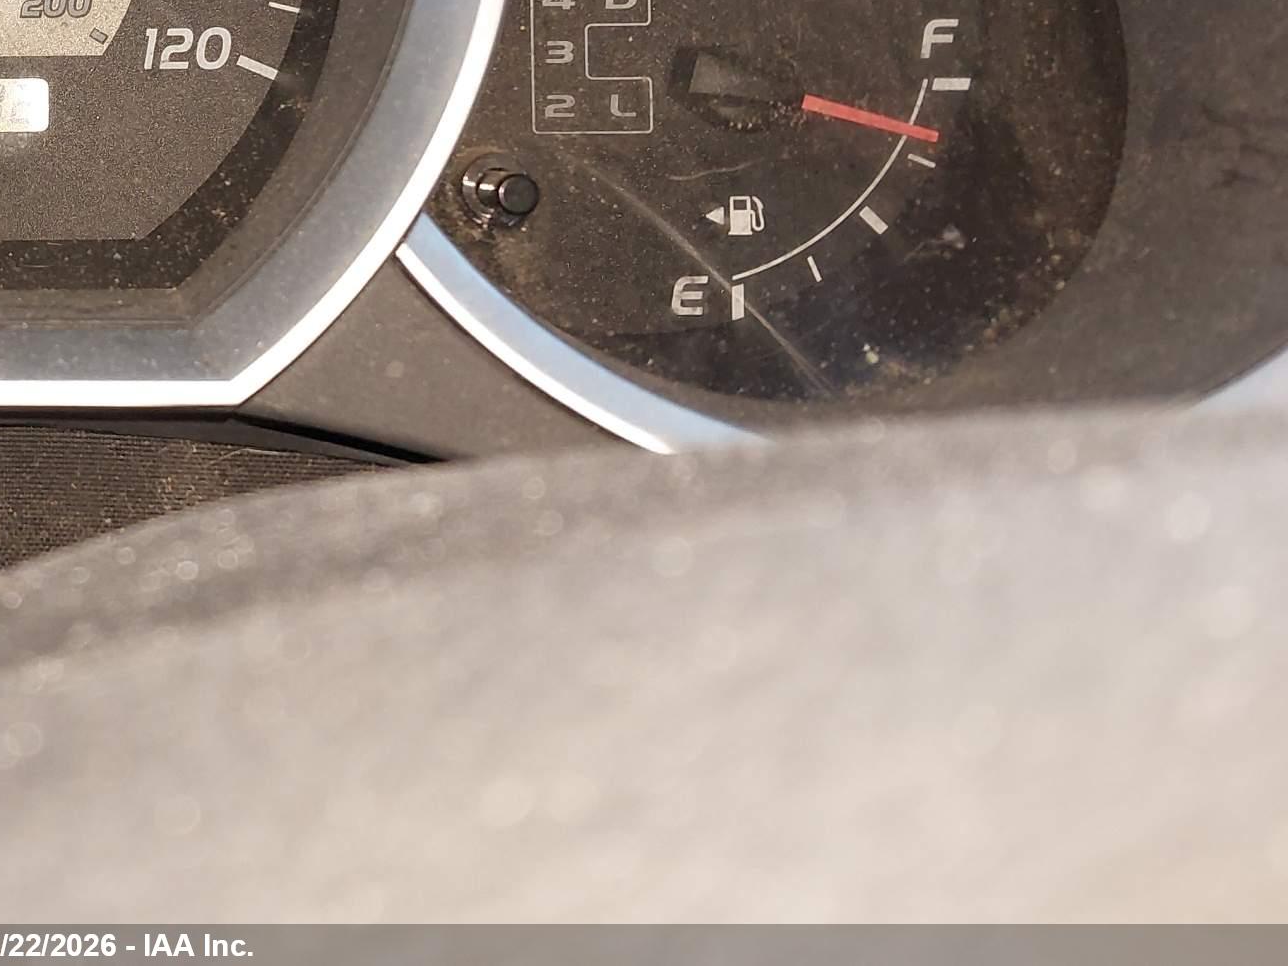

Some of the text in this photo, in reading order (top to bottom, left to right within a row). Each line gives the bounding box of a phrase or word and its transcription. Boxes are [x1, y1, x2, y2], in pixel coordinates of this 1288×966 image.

[144, 27, 232, 70] 120
[546, 41, 575, 63] 3
[921, 19, 959, 59] F
[545, 95, 576, 117] 2
[610, 95, 637, 117] L
[671, 276, 709, 316] E
